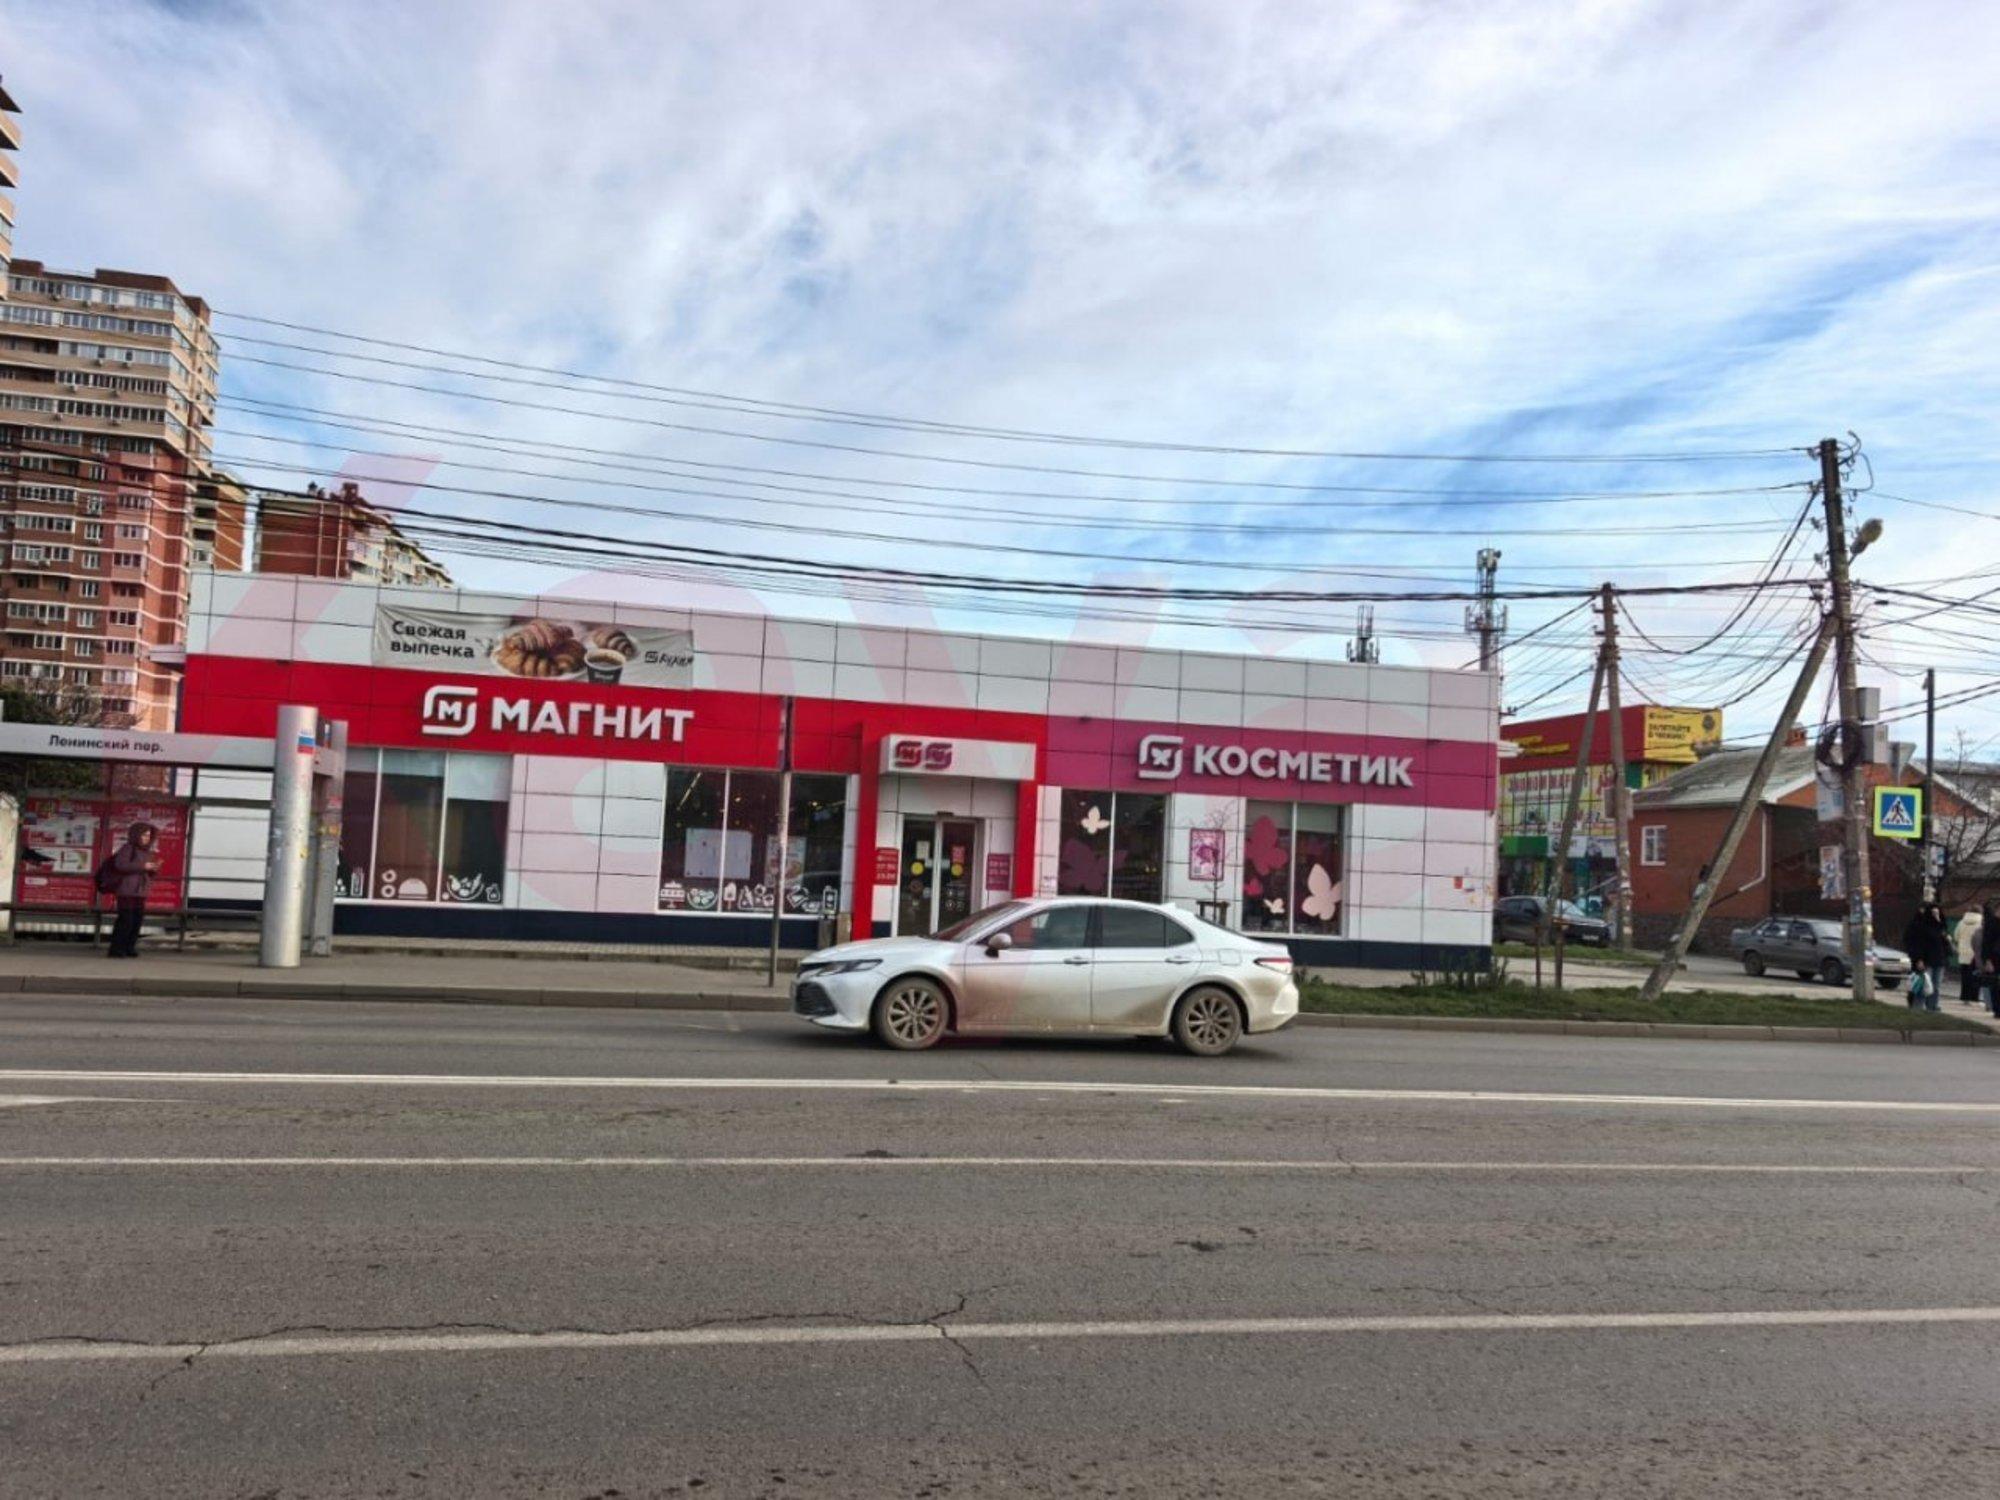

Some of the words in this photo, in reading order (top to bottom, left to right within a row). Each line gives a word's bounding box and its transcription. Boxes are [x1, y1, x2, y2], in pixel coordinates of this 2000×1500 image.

[391, 619, 468, 640] Свежая
[390, 640, 476, 659] выпечка
[491, 696, 695, 743] МАГНИТ
[49, 734, 129, 751] Ленинский
[133, 741, 164, 754] пер.
[1193, 743, 1414, 788] КОСМЕТИК
